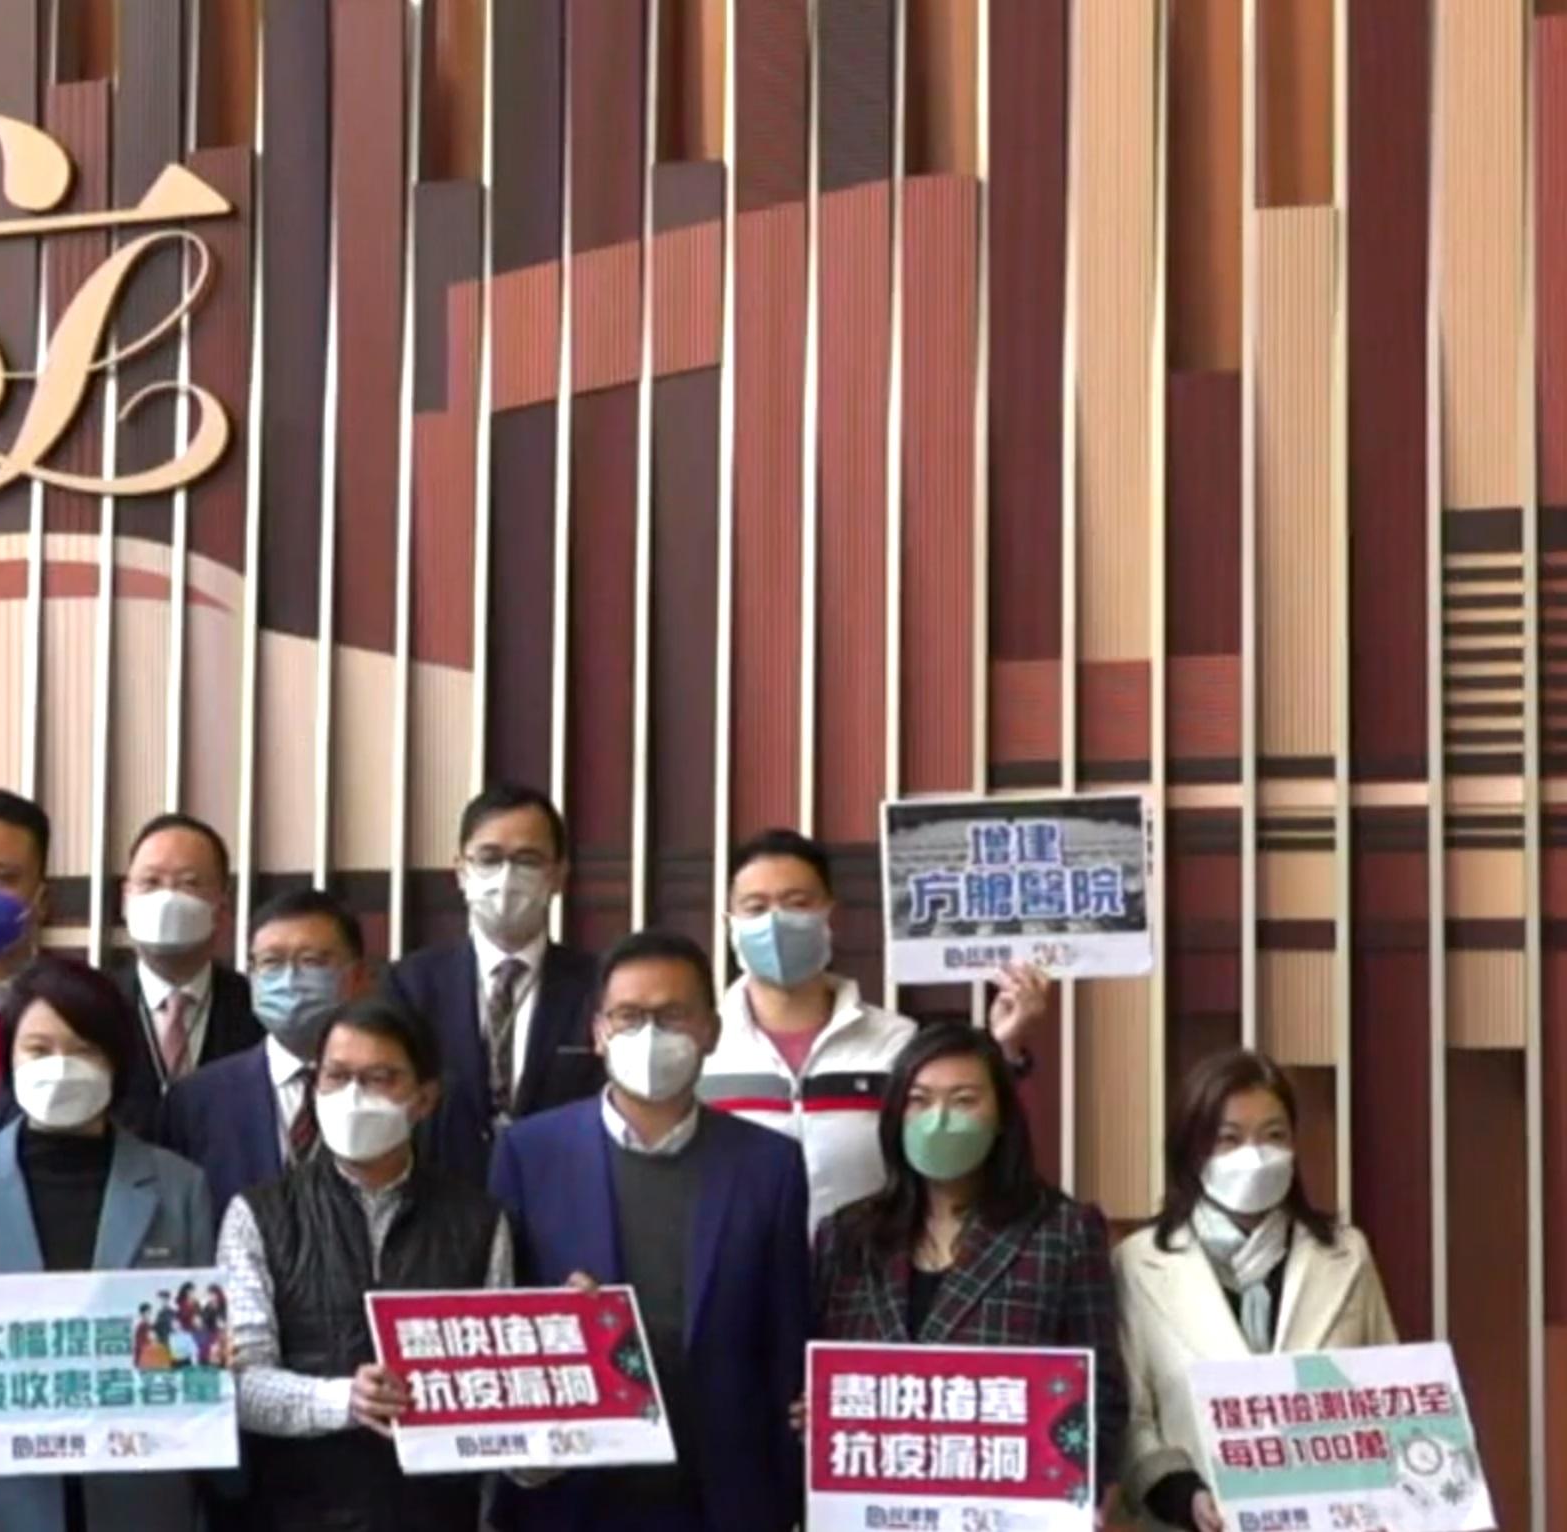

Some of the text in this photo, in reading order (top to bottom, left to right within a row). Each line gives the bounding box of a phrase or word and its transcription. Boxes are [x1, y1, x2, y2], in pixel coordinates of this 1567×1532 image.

[971, 823, 1059, 864] 增建
[912, 867, 1121, 918] 方艙醫院
[395, 1314, 587, 1359] 盡快堵塞
[407, 1364, 600, 1412] 抗疫漏洞
[830, 1373, 1028, 1424] 盡快堵塞
[1211, 1383, 1450, 1429] 提升檢測能力至
[829, 1431, 1028, 1482] 抗疫漏洞
[1219, 1430, 1387, 1468] 每日100萬
